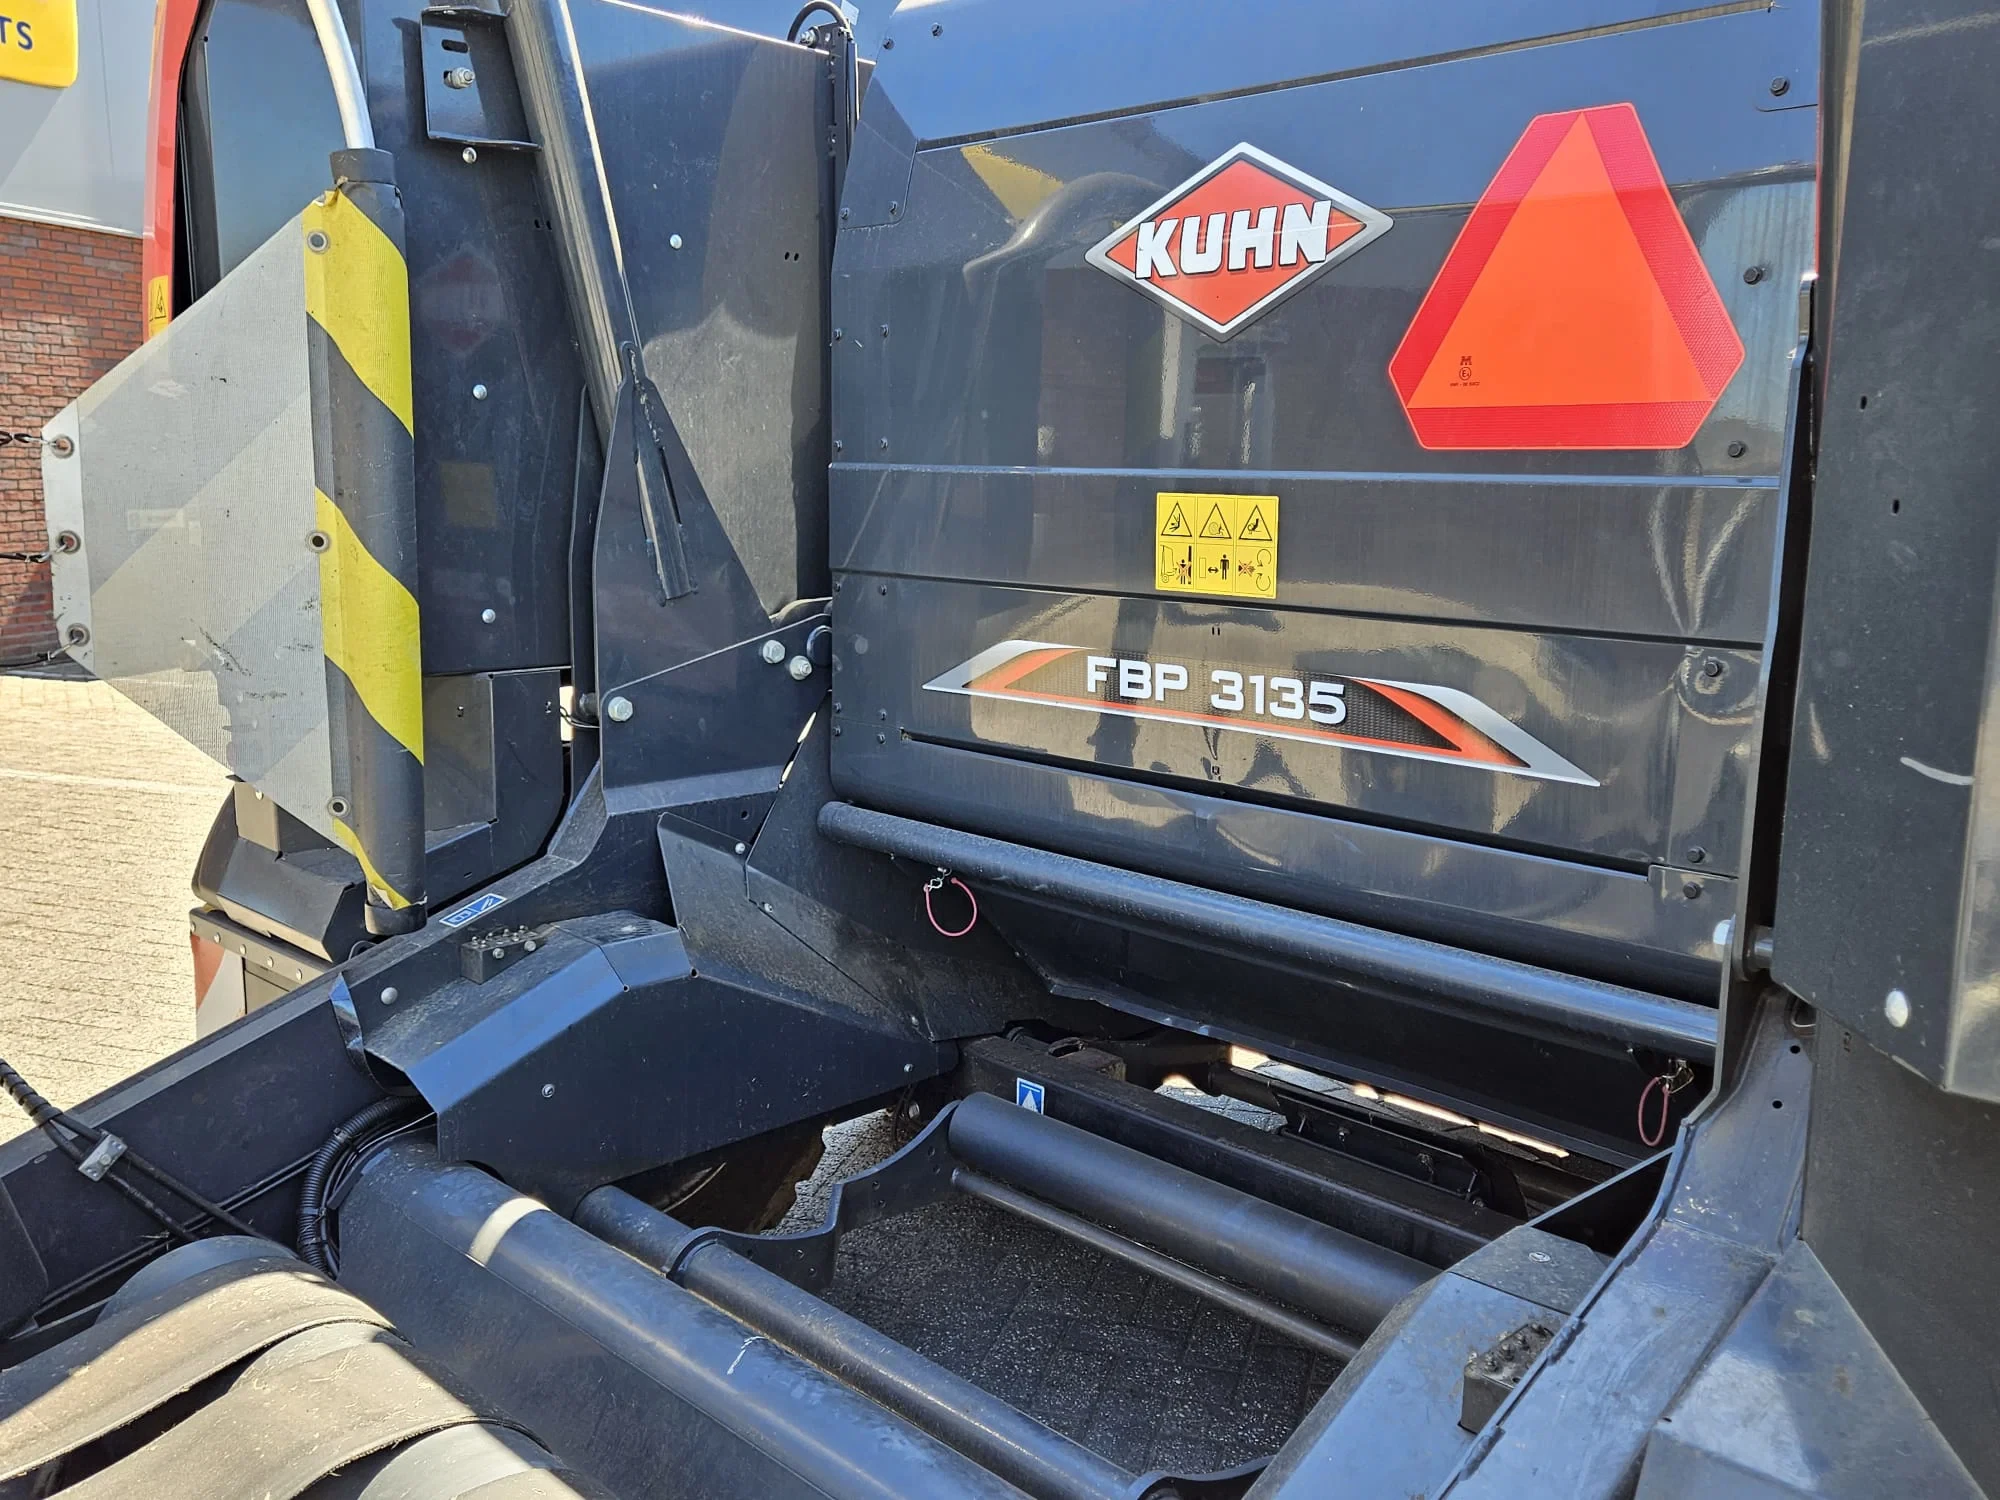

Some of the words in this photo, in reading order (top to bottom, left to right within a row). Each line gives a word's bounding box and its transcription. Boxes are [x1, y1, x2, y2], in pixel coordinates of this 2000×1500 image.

[1135, 200, 1332, 279] KUHN
[1087, 655, 1189, 701] FBP
[1210, 669, 1347, 724] 3135
